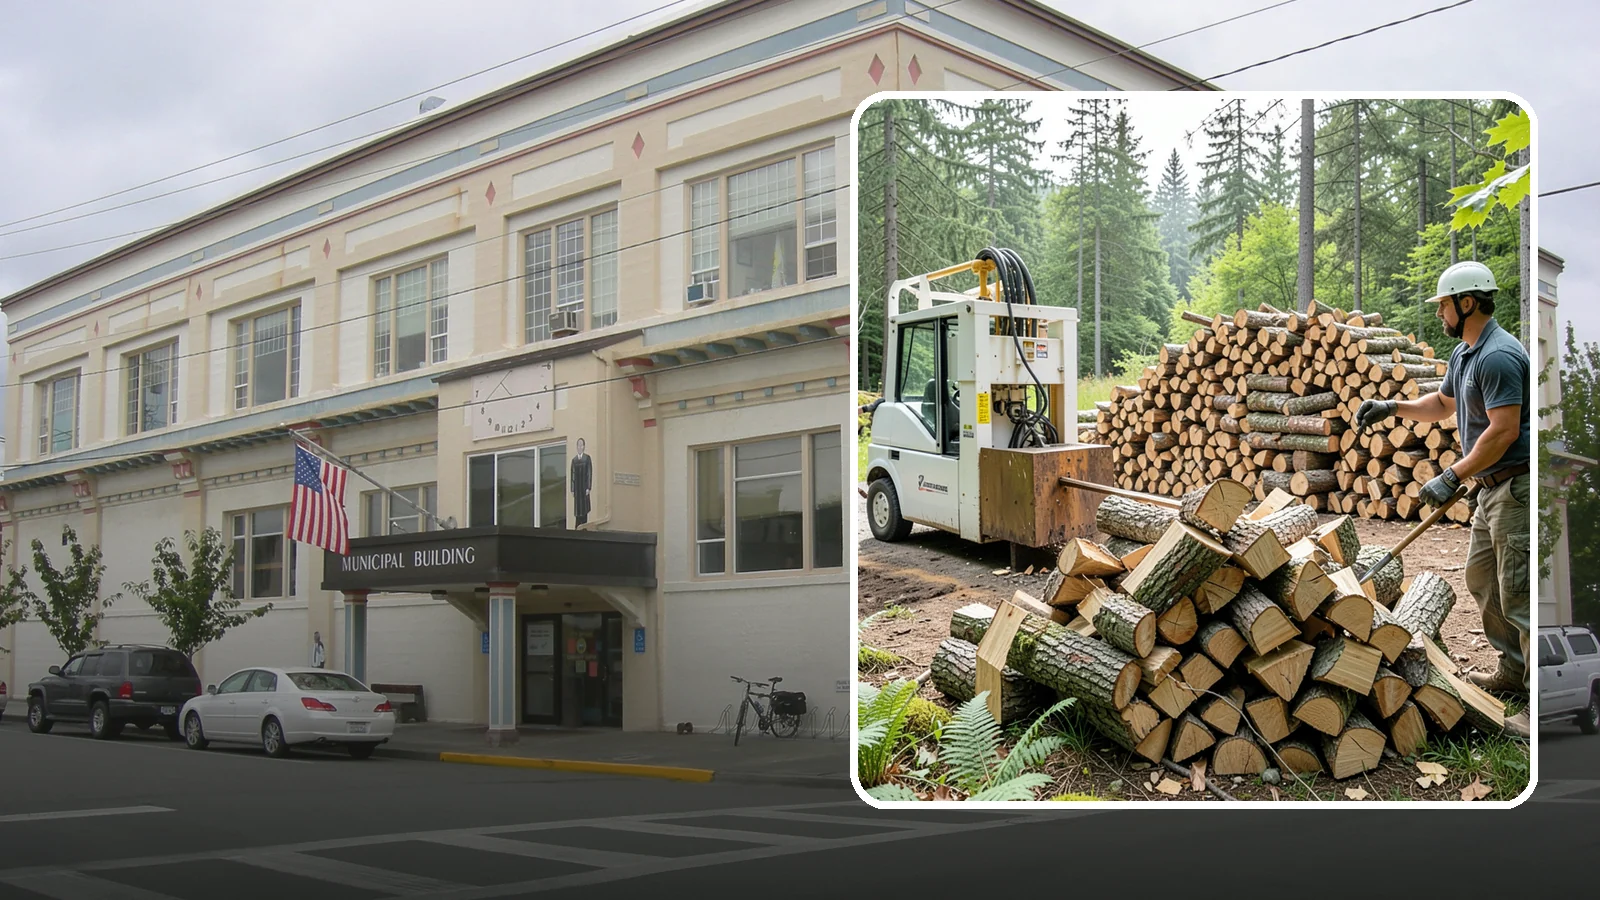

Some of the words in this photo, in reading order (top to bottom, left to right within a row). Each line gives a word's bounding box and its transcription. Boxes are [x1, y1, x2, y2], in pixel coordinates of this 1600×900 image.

[546, 362, 551, 370] 6
[480, 406, 484, 414] 8
[529, 414, 533, 422] 3
[342, 552, 405, 572] MUNICIPAL
[414, 546, 476, 567] BUILDING
